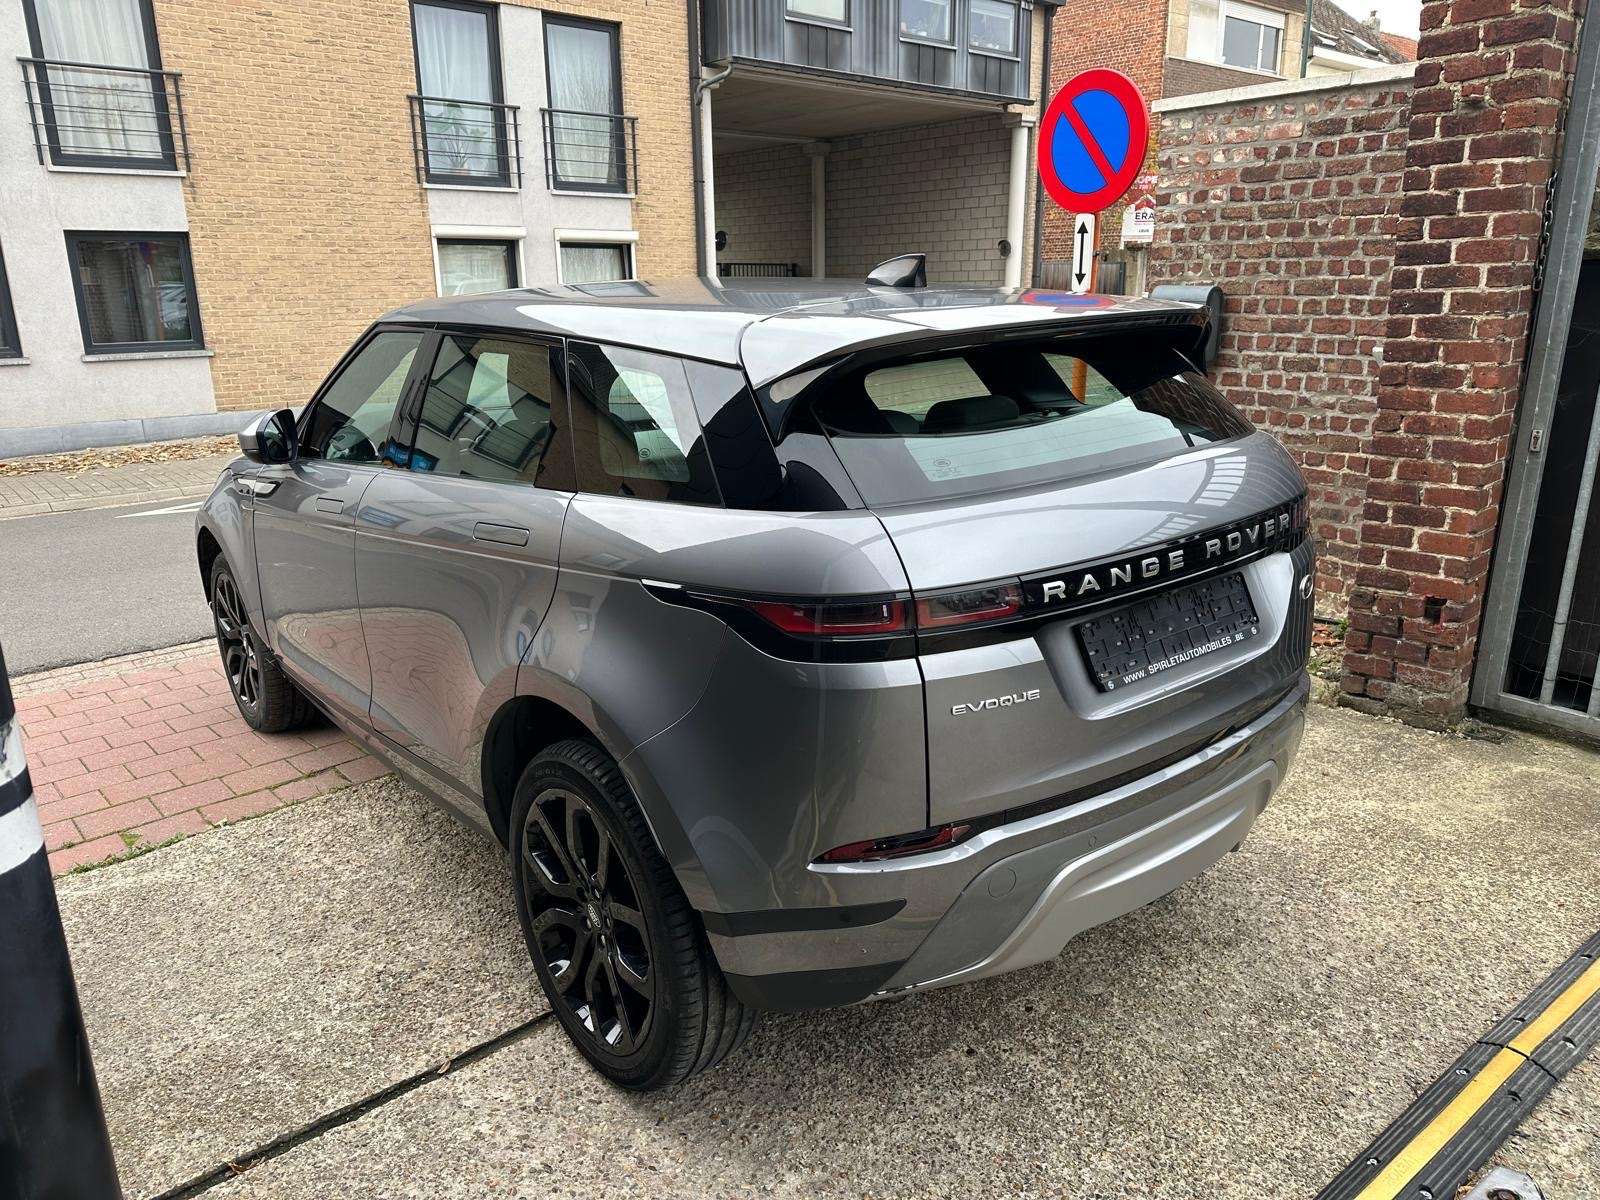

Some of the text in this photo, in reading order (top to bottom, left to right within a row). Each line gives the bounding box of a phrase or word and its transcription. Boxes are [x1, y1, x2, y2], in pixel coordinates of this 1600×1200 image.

[1134, 212, 1155, 220] ERA
[1043, 513, 1290, 603] RANGE ROVER
[1148, 637, 1232, 674] SPIRLETAUTOMOBILES
[951, 689, 1040, 715] EVOQUE
